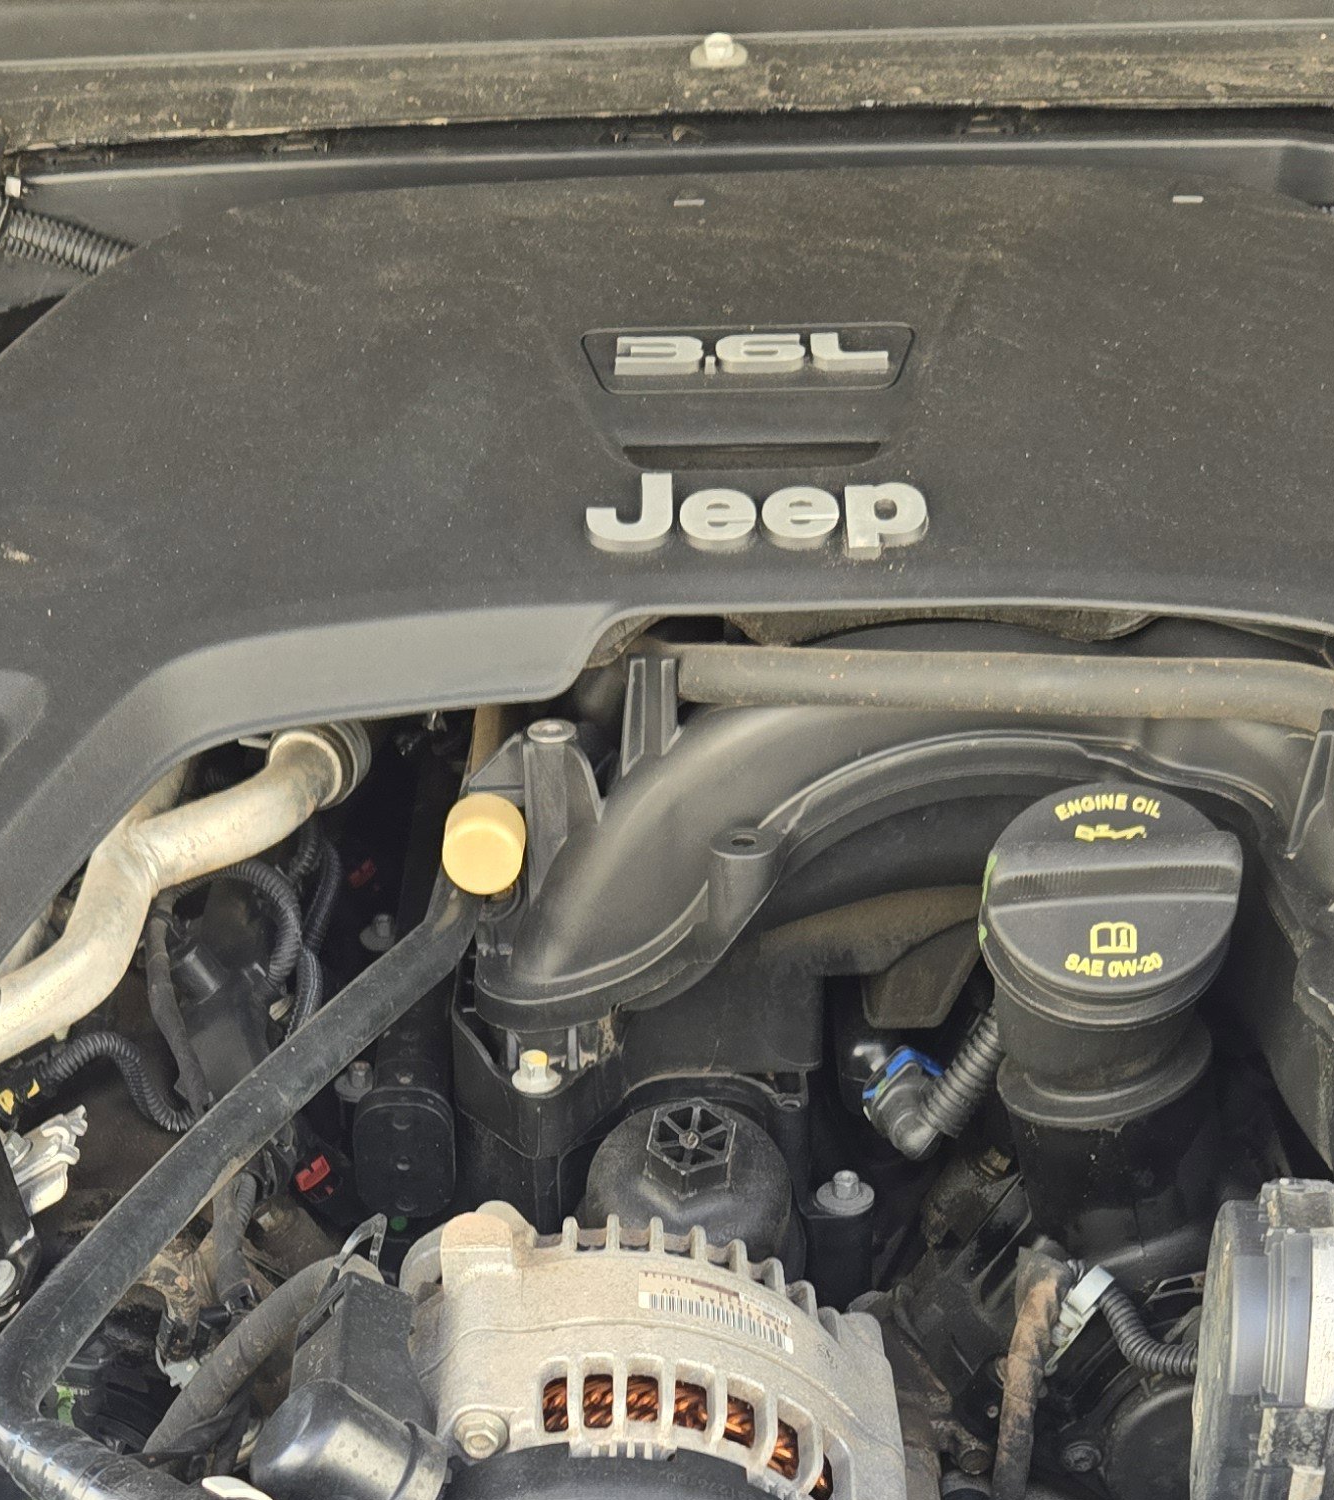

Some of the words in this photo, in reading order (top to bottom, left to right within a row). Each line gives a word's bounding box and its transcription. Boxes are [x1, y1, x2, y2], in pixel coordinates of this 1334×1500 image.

[585, 471, 929, 560] Jeep
[1054, 793, 1128, 821] ENGINE
[1132, 796, 1162, 819] OIL
[1065, 952, 1104, 978] SAE
[1107, 951, 1163, 978] 0W-20
